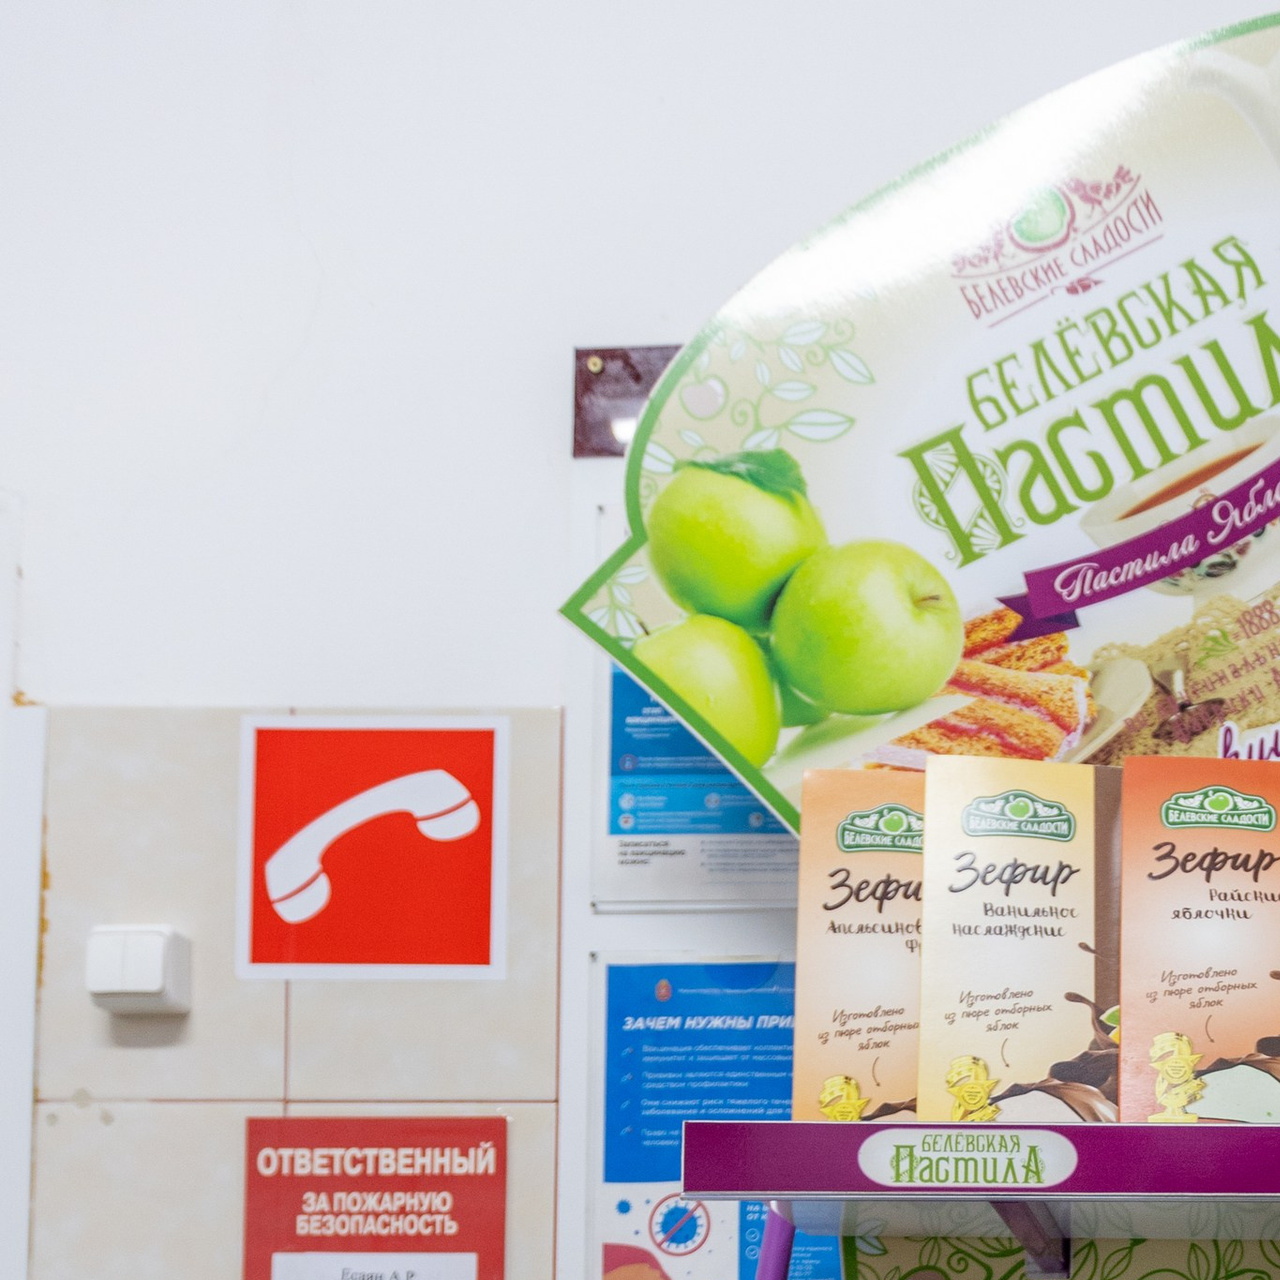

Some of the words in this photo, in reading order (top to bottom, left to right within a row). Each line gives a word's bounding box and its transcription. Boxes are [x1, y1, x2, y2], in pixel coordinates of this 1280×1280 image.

[959, 256, 1069, 321] БЕЛЕВСКИЕ
[1070, 189, 1165, 276] СЛАДОСТИ
[966, 234, 1267, 433] БЕЛЁВСКАЯ
[1054, 532, 1199, 606] Пастила
[968, 815, 1020, 831] БЕЛЕВСКИЕ
[1020, 820, 1069, 835] СЛАДОСТИ
[1168, 809, 1219, 825] БЕЛЕВСКИЕ
[1221, 811, 1270, 826] СЛАДОСТИ
[844, 831, 892, 847] БЕЛЕВСКИЕ
[948, 851, 1081, 897] Зефир
[823, 867, 923, 913] Зефи
[983, 901, 1079, 919] Ванильное
[1171, 906, 1253, 921] яблочки
[952, 922, 1067, 938] наслаждение
[1161, 967, 1238, 986] Изготовлено
[959, 987, 1034, 1006] Изготовлено
[1146, 989, 1158, 1003] из
[1163, 985, 1193, 1000] пюре
[1197, 980, 1258, 995] отборных
[944, 1012, 956, 1026] из
[961, 1008, 990, 1022] пюре
[994, 1002, 1053, 1018] отборных
[1189, 997, 1224, 1010] яблок
[622, 1016, 682, 1032] ЗАЧЕМ
[684, 1014, 754, 1031] НУЖНЫ
[755, 1014, 795, 1030] ПРИ
[832, 1005, 905, 1026] Изготовлено
[818, 1031, 831, 1045] из
[834, 1026, 863, 1041] пюре
[866, 1019, 919, 1035] отборны
[986, 1020, 1020, 1033] яблок
[858, 1039, 890, 1052] яблок
[921, 1132, 1022, 1158] БЕЛЁВСКАЯ
[256, 1141, 496, 1176] ОТВЕТСТВЕННЫЙ
[302, 1191, 331, 1213] ЗА
[333, 1191, 453, 1213] ПОЖАРНУЮ
[296, 1214, 458, 1236] БЕЗОПАСНОСТЬ
